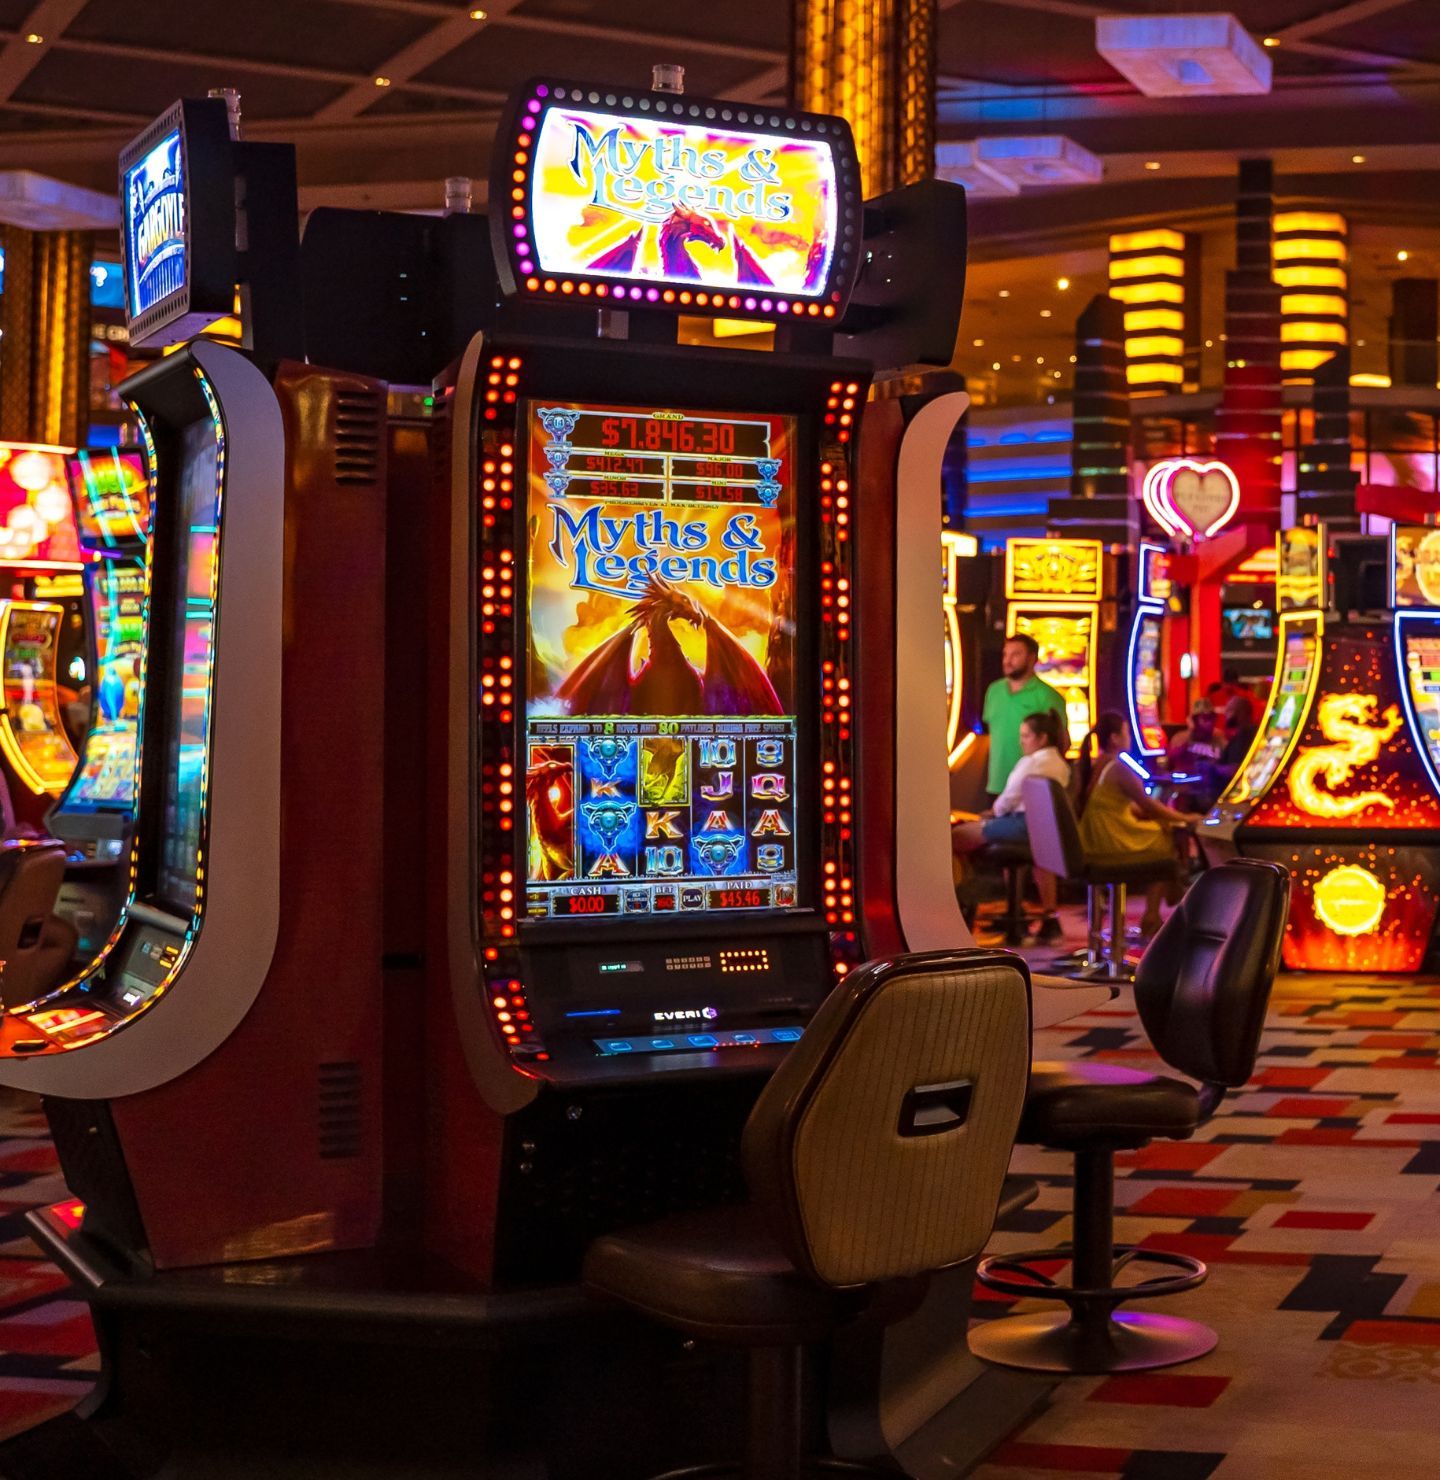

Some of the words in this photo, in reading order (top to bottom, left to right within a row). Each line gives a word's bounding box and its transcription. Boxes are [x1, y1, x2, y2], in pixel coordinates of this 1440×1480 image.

[568, 122, 726, 186] Myths
[740, 147, 781, 184] &
[588, 157, 793, 223] Legends
[586, 457, 644, 473] $412.47
[696, 486, 743, 501] $14.58
[547, 503, 709, 568] Myths
[721, 513, 766, 551] &
[570, 535, 778, 598] Legends
[604, 722, 614, 734] 8
[659, 722, 679, 734] 80
[700, 739, 737, 768] 10
[756, 739, 784, 768] 9
[701, 771, 733, 802] J
[751, 773, 790, 802] Q
[645, 811, 684, 838] K
[704, 810, 732, 831] A
[751, 809, 791, 837] A
[588, 852, 631, 877] A
[645, 846, 684, 875] 10
[757, 843, 784, 872] 9
[570, 887, 602, 895] CASH
[720, 890, 760, 907] $45.46
[727, 881, 754, 890] PAID
[569, 896, 605, 913] $0.00
[653, 1010, 701, 1020] EVERI
